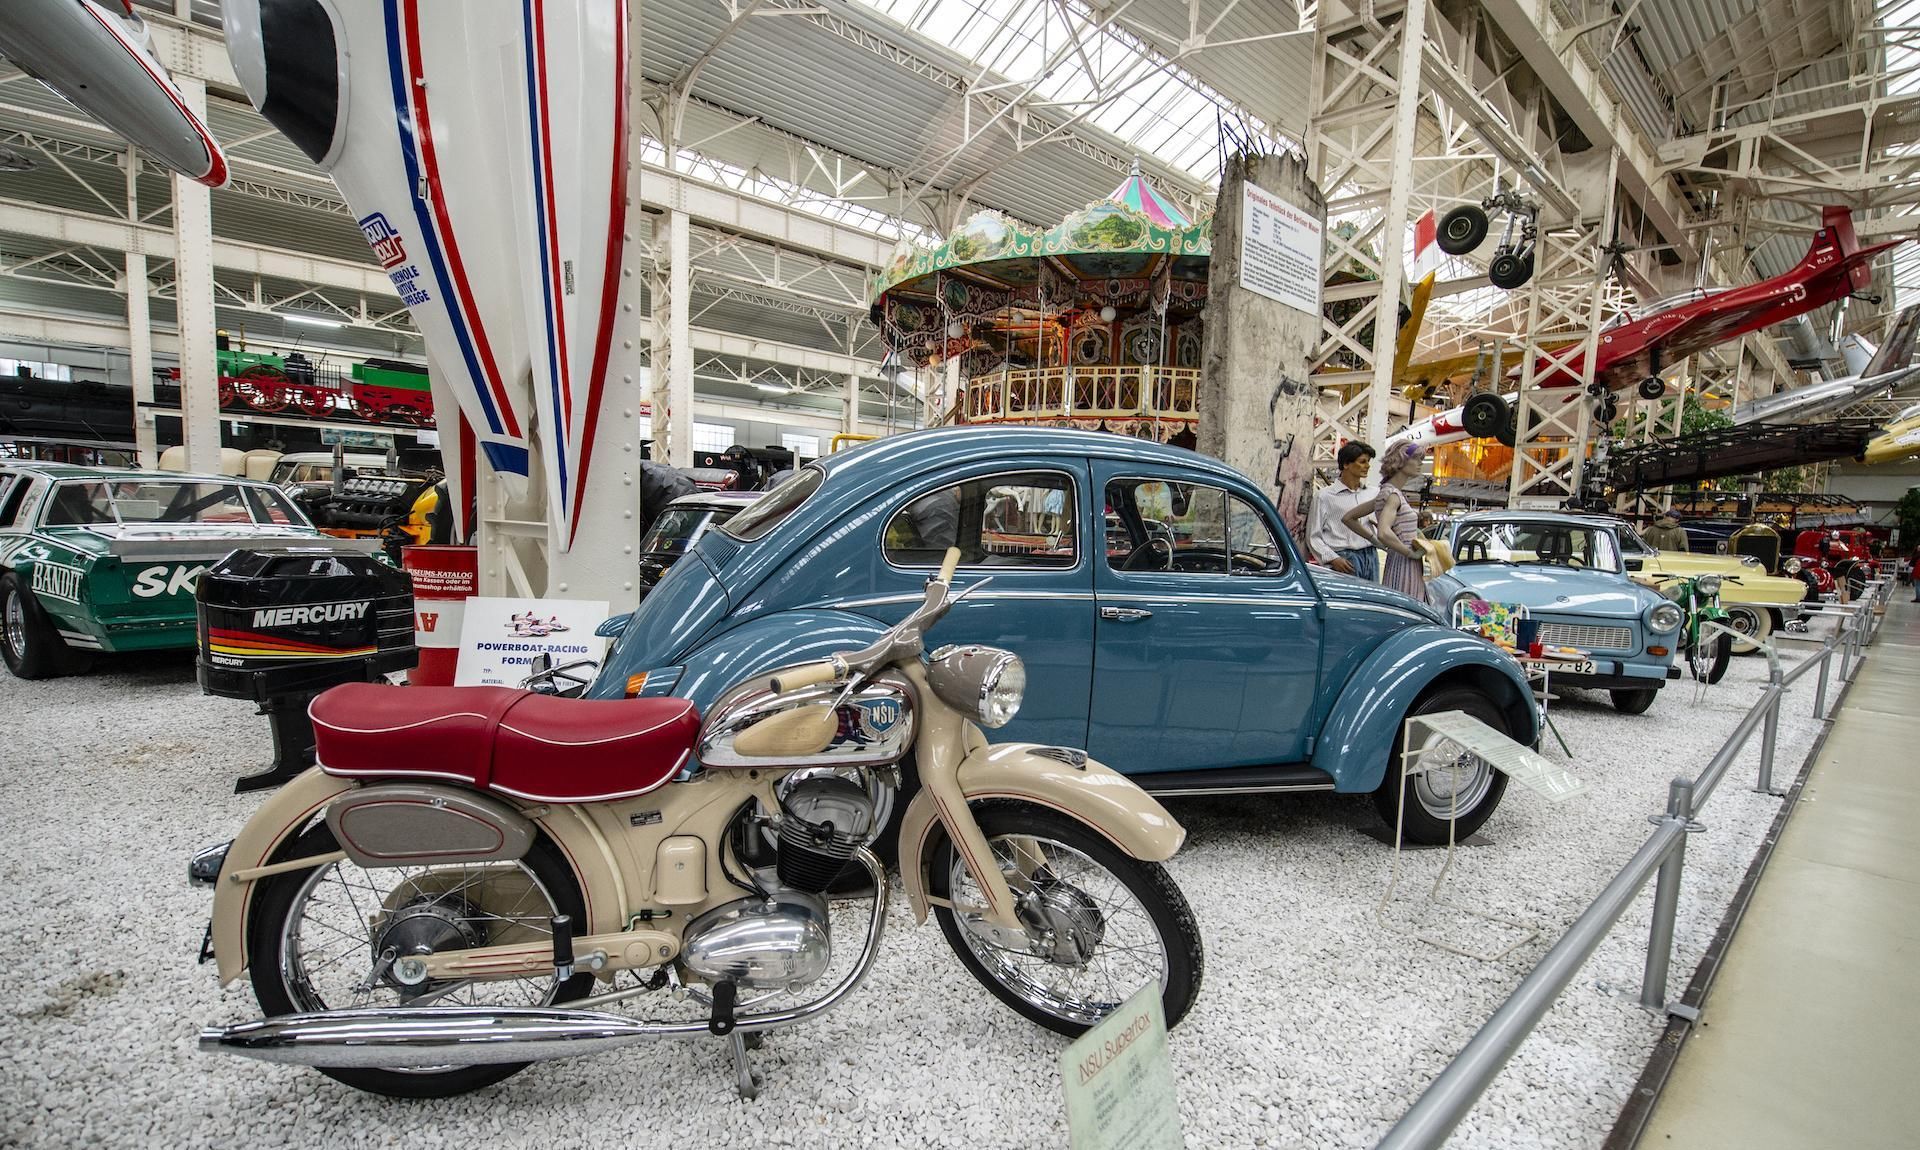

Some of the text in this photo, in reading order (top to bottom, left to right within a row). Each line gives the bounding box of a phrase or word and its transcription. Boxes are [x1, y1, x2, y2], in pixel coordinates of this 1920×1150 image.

[364, 222, 387, 246] QUI
[32, 562, 84, 601] BANDIT
[132, 564, 205, 598] SK
[252, 601, 370, 628] MERCURY
[477, 642, 588, 653] POWERBOAT-RACING
[211, 655, 245, 667] MERCURY
[501, 657, 532, 665] FORM
[872, 705, 895, 724] NSU
[1079, 1047, 1103, 1082] NSU
[1104, 1010, 1152, 1057] Superfox
